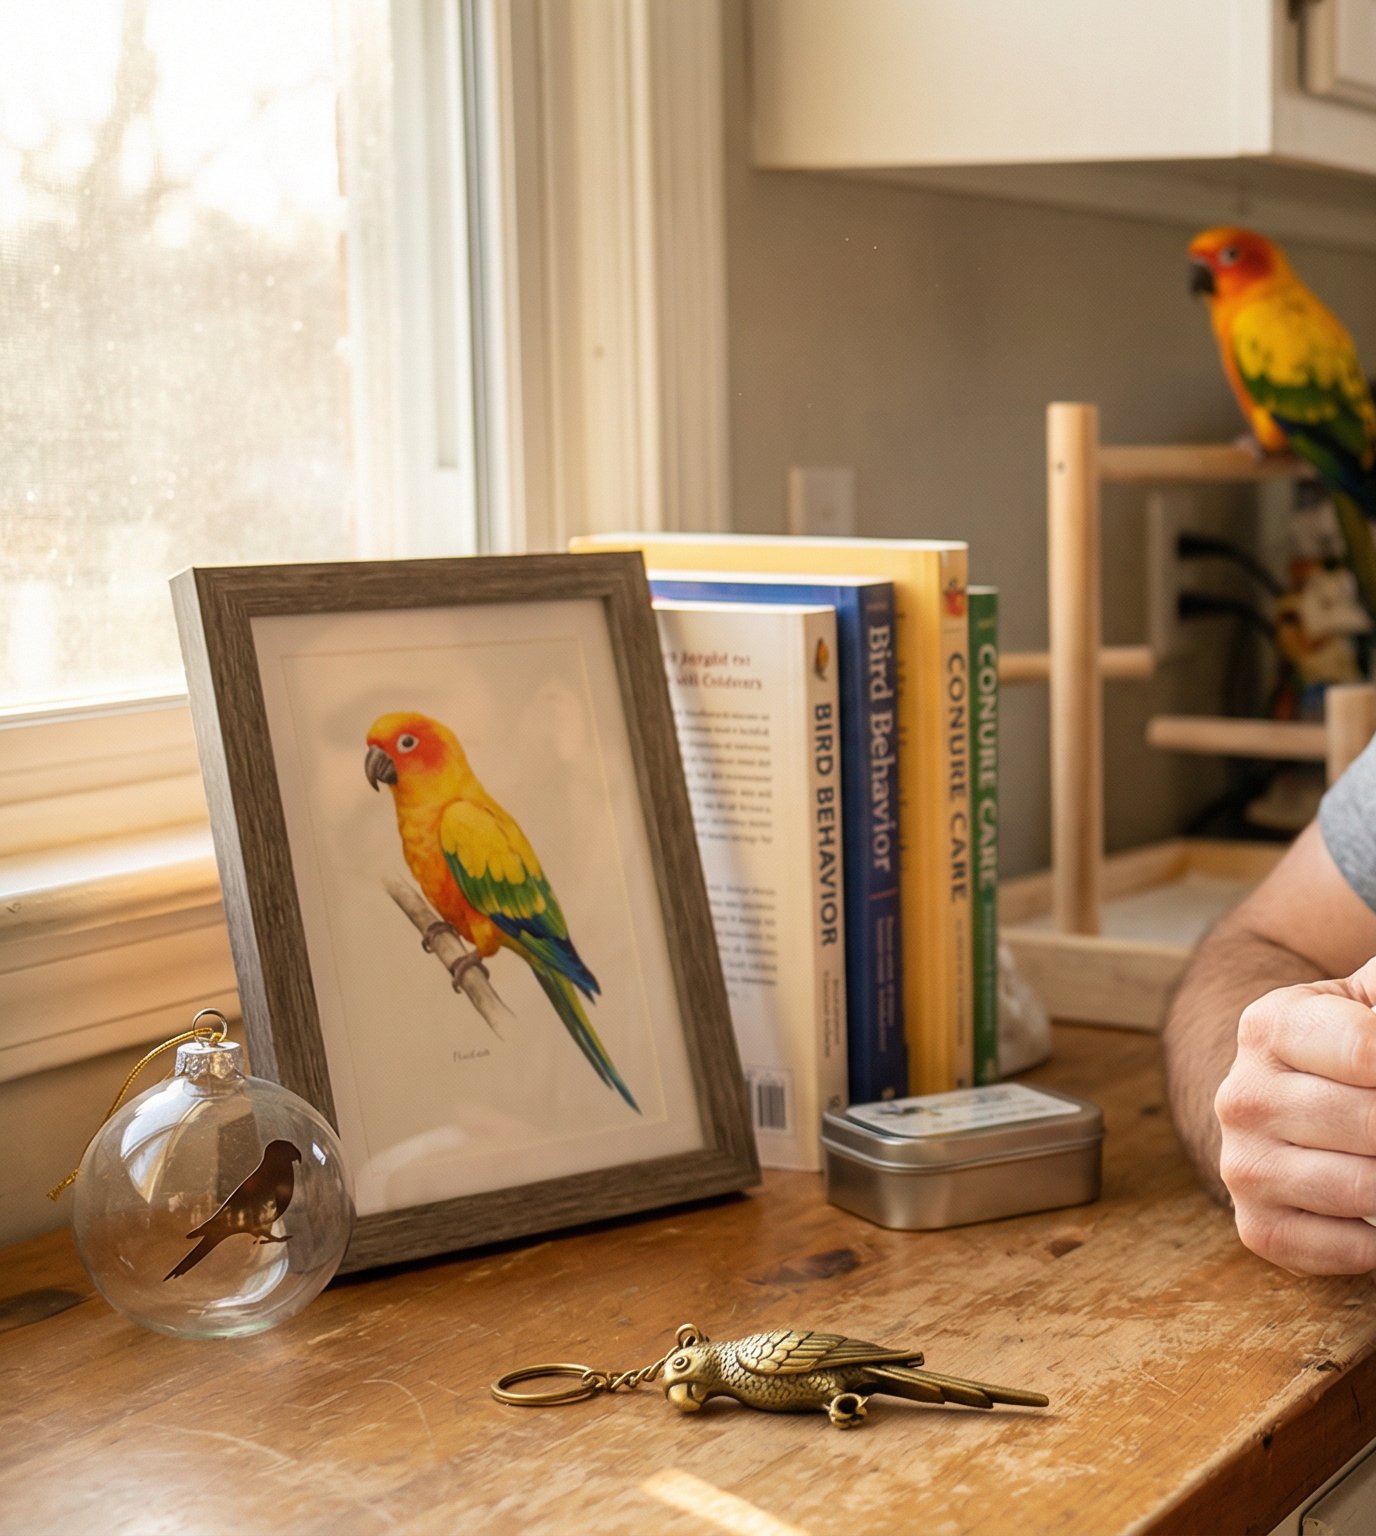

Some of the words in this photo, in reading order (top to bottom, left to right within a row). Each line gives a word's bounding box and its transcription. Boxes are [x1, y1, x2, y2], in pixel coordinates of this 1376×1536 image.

[868, 624, 894, 701] Bird
[977, 643, 998, 790] CONURE
[814, 703, 834, 776] BIRD
[947, 652, 967, 799] CONURE
[869, 709, 896, 873] Behavior
[977, 799, 998, 891] CARE
[816, 787, 839, 947] BEHAVIOR
[950, 812, 969, 903] CARE
